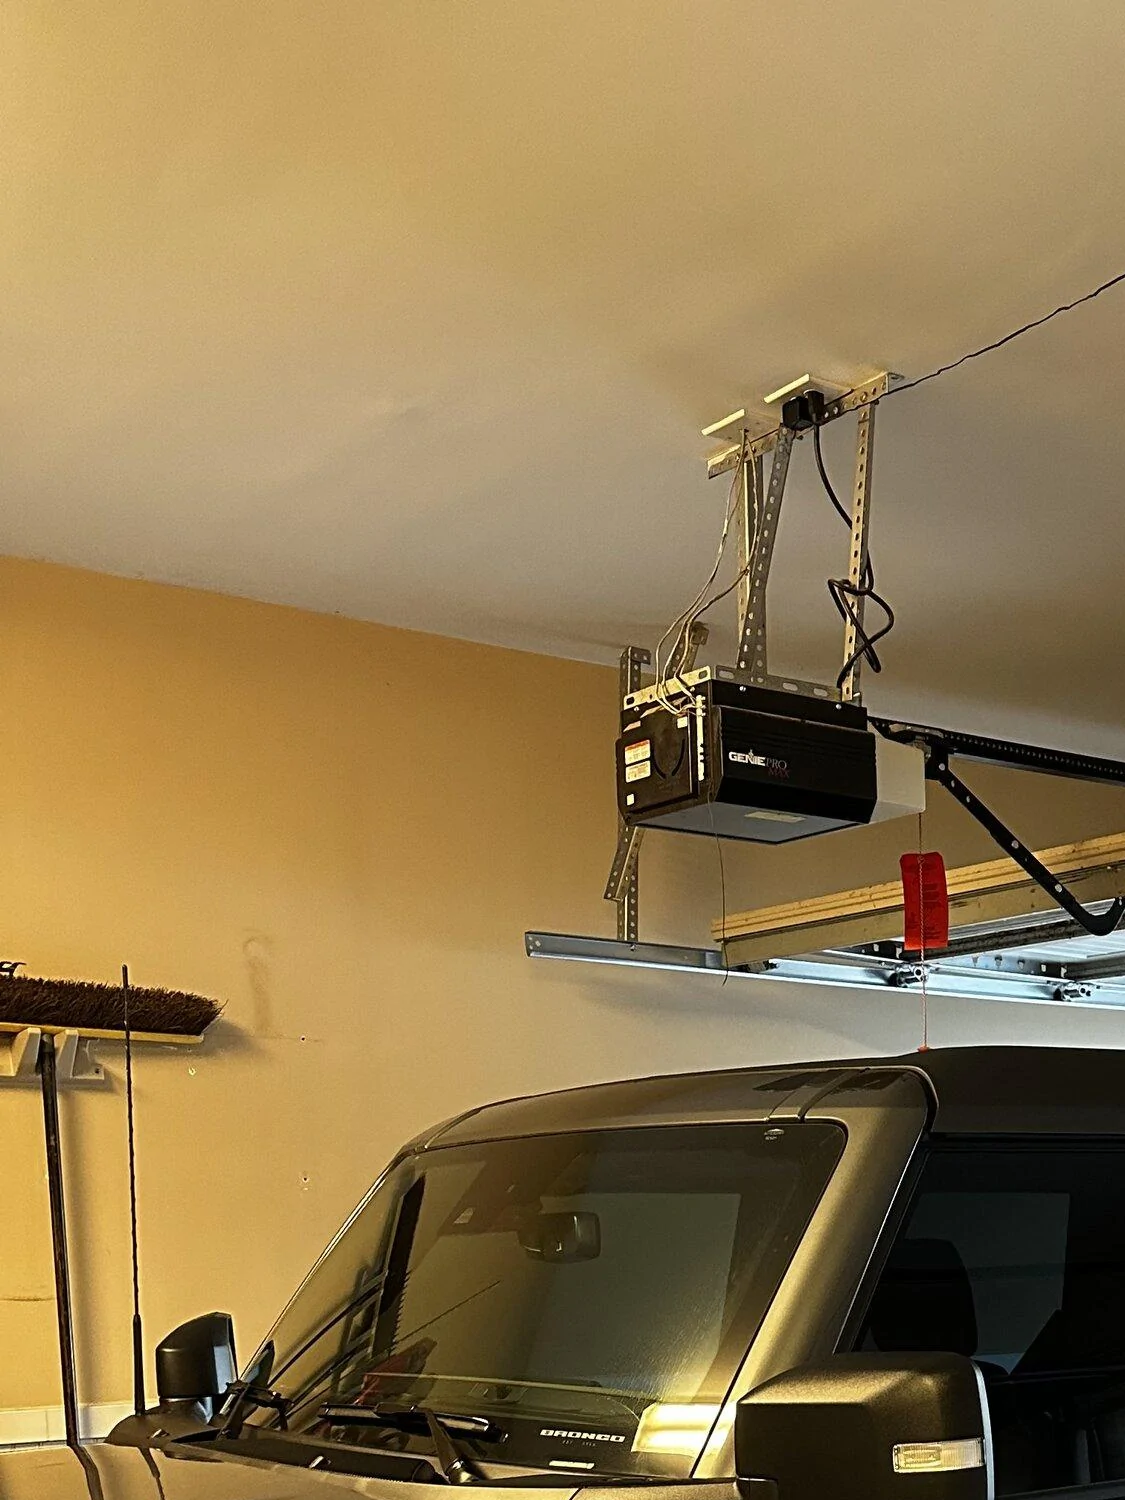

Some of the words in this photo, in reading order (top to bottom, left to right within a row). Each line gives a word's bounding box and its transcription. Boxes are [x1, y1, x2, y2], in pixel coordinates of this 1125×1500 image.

[729, 750, 766, 767] GENIE
[766, 757, 788, 770] PRO
[540, 1429, 626, 1443] BRONCO
